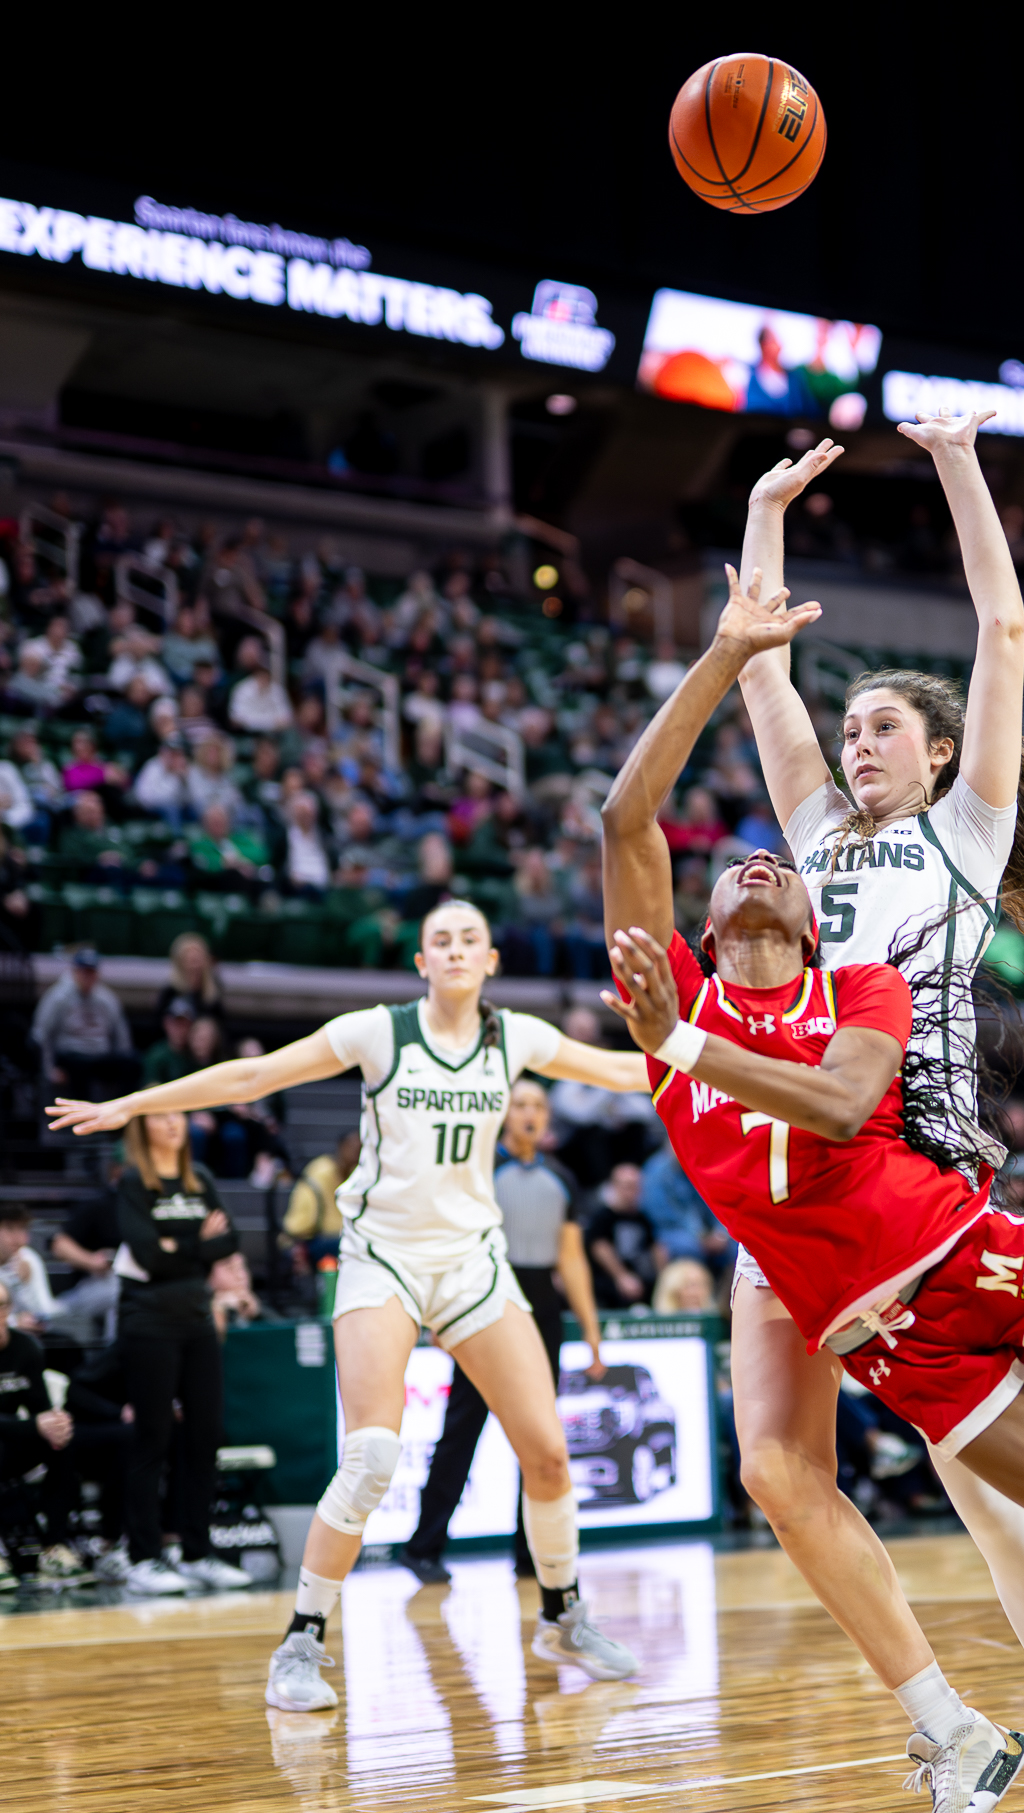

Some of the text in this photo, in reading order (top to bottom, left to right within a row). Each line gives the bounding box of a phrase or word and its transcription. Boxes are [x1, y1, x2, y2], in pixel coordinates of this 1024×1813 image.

[820, 883, 859, 943] 5
[397, 1088, 503, 1112] SPARTANS
[433, 1123, 475, 1165] 10
[740, 1110, 790, 1205] 7
